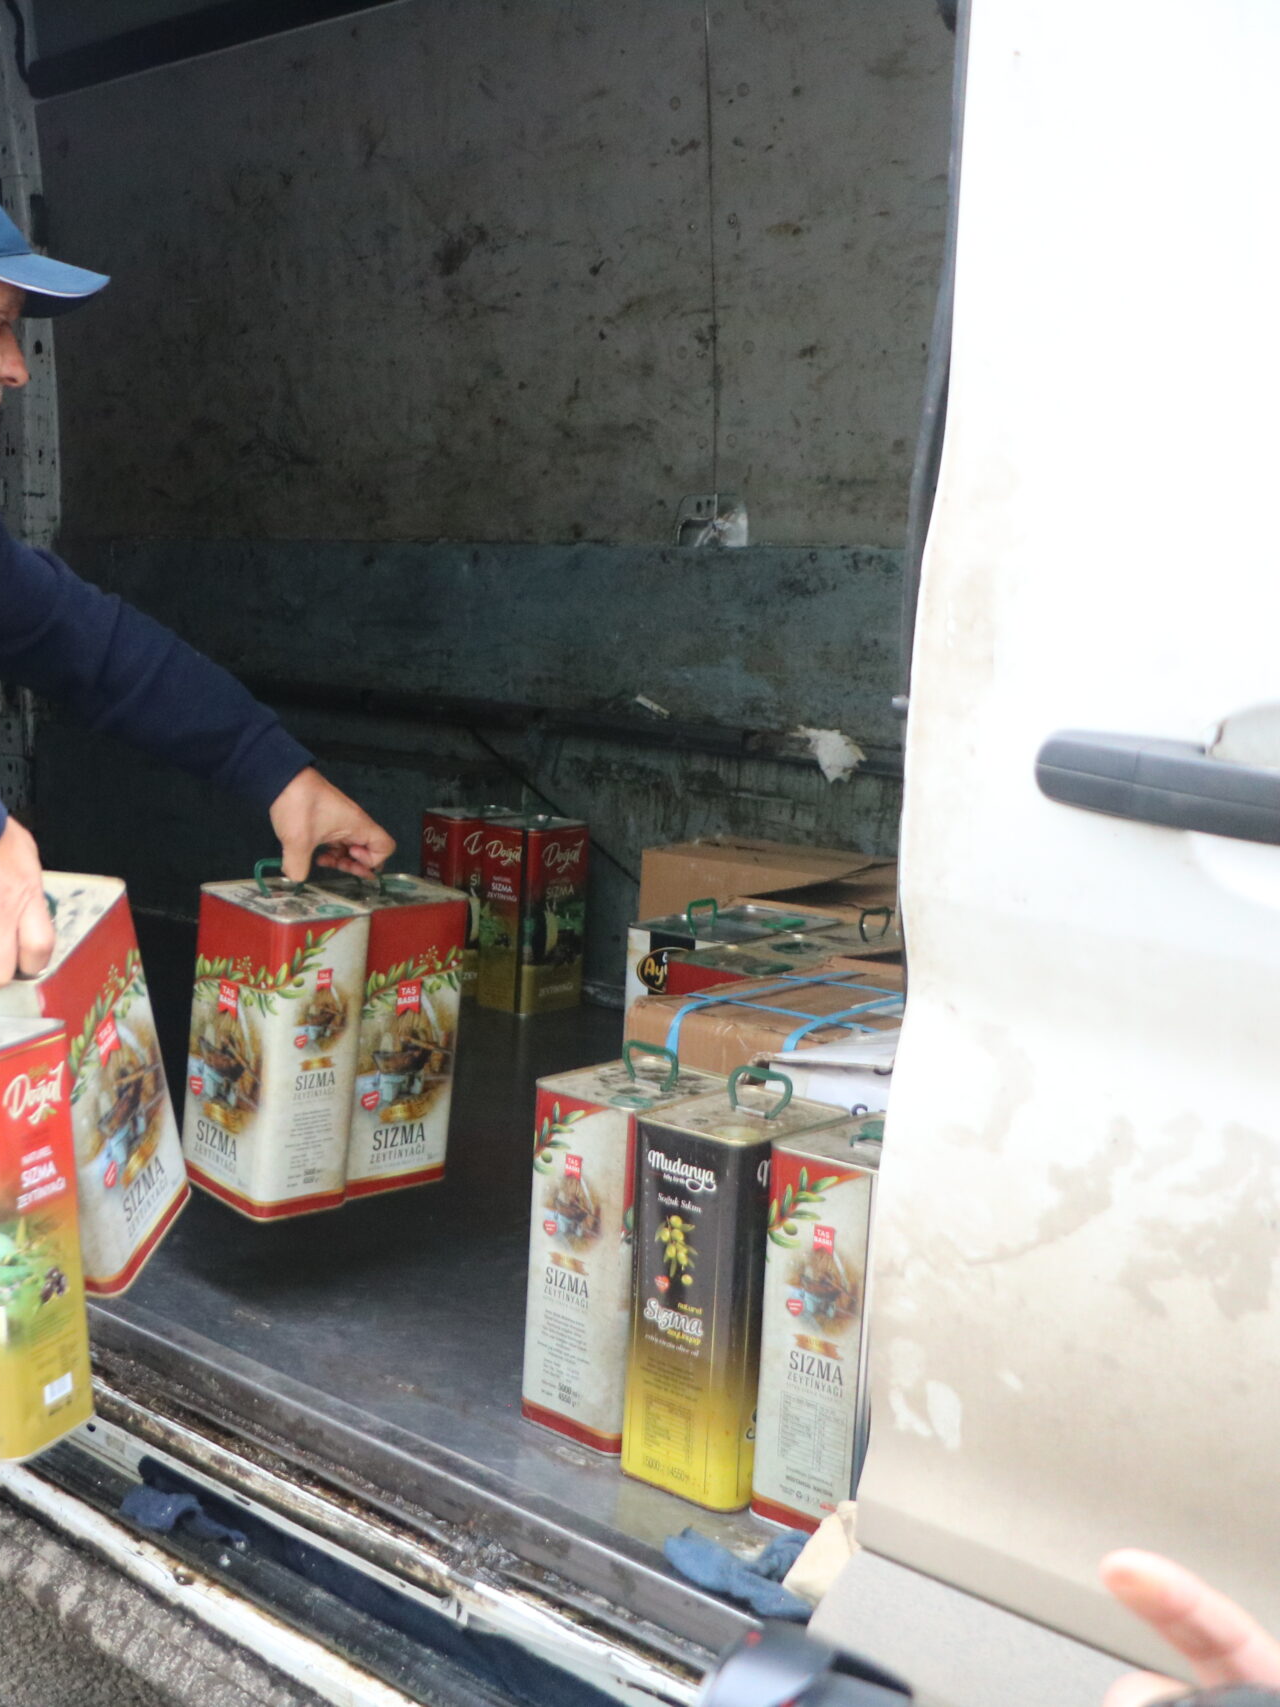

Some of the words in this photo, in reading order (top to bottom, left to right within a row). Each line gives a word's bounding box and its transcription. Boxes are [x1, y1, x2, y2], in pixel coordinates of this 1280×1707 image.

[491, 883, 513, 893] SIZMA
[546, 885, 575, 899] SIZMA
[2, 1060, 65, 1126] Doğal
[295, 1070, 336, 1091] SIZMA
[196, 1120, 237, 1161] SIZMA
[372, 1122, 425, 1152] SIZMA
[648, 1149, 717, 1192] Mudanya
[123, 1155, 165, 1222] SIZMA
[545, 1267, 589, 1298] SIZMA
[789, 1350, 843, 1386] SIZMA
